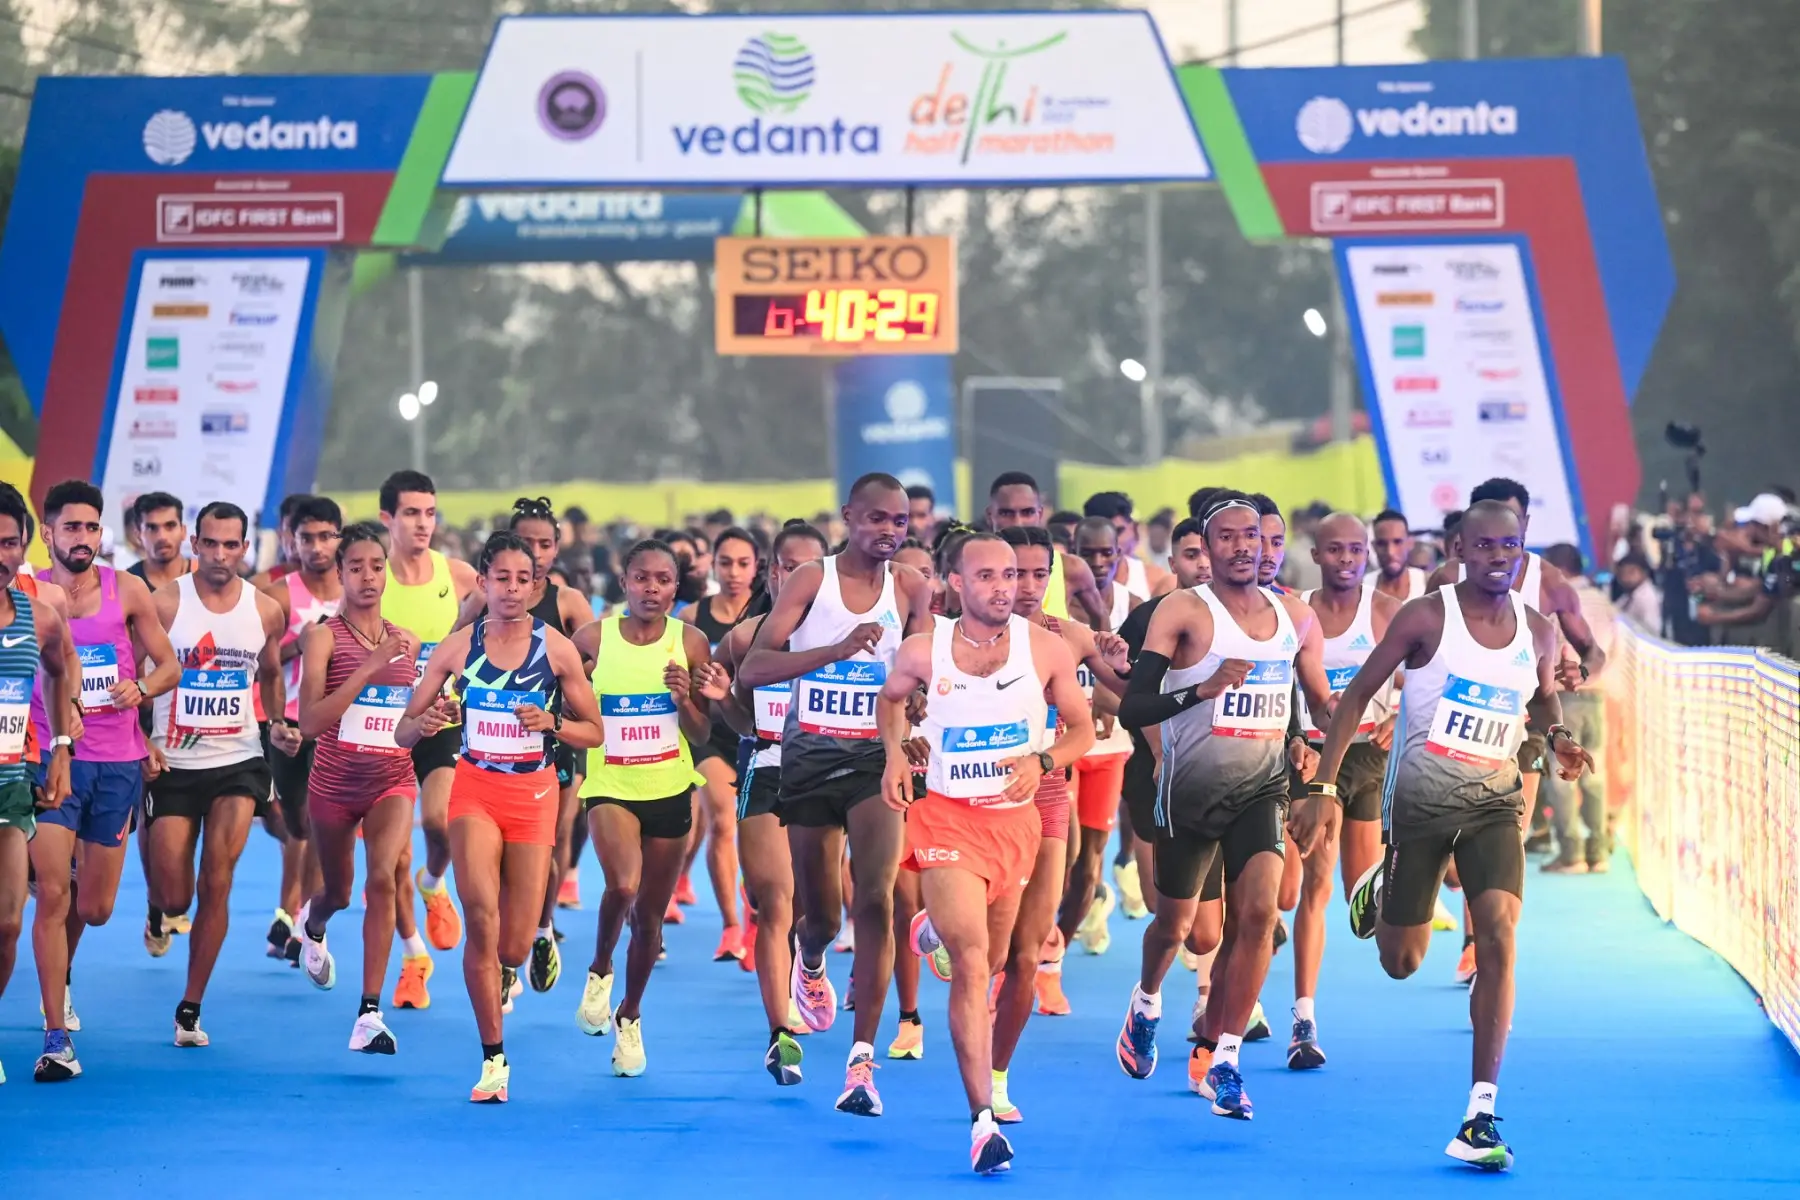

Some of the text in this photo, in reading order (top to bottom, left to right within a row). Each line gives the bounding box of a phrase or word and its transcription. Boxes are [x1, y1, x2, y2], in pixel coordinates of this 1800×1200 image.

[909, 55, 1038, 165] delhi
[1357, 101, 1518, 137] vedanta
[202, 115, 358, 150] vedanta
[672, 117, 881, 154] vedanta
[742, 245, 928, 282] SEIKO
[184, 695, 242, 716] VIKAS
[808, 687, 878, 717] BELET
[1222, 692, 1287, 718] EDRIS
[364, 716, 396, 733] GETE
[621, 725, 661, 741] FAITH
[1445, 710, 1510, 748] FELIX
[914, 848, 960, 862] INEOS
